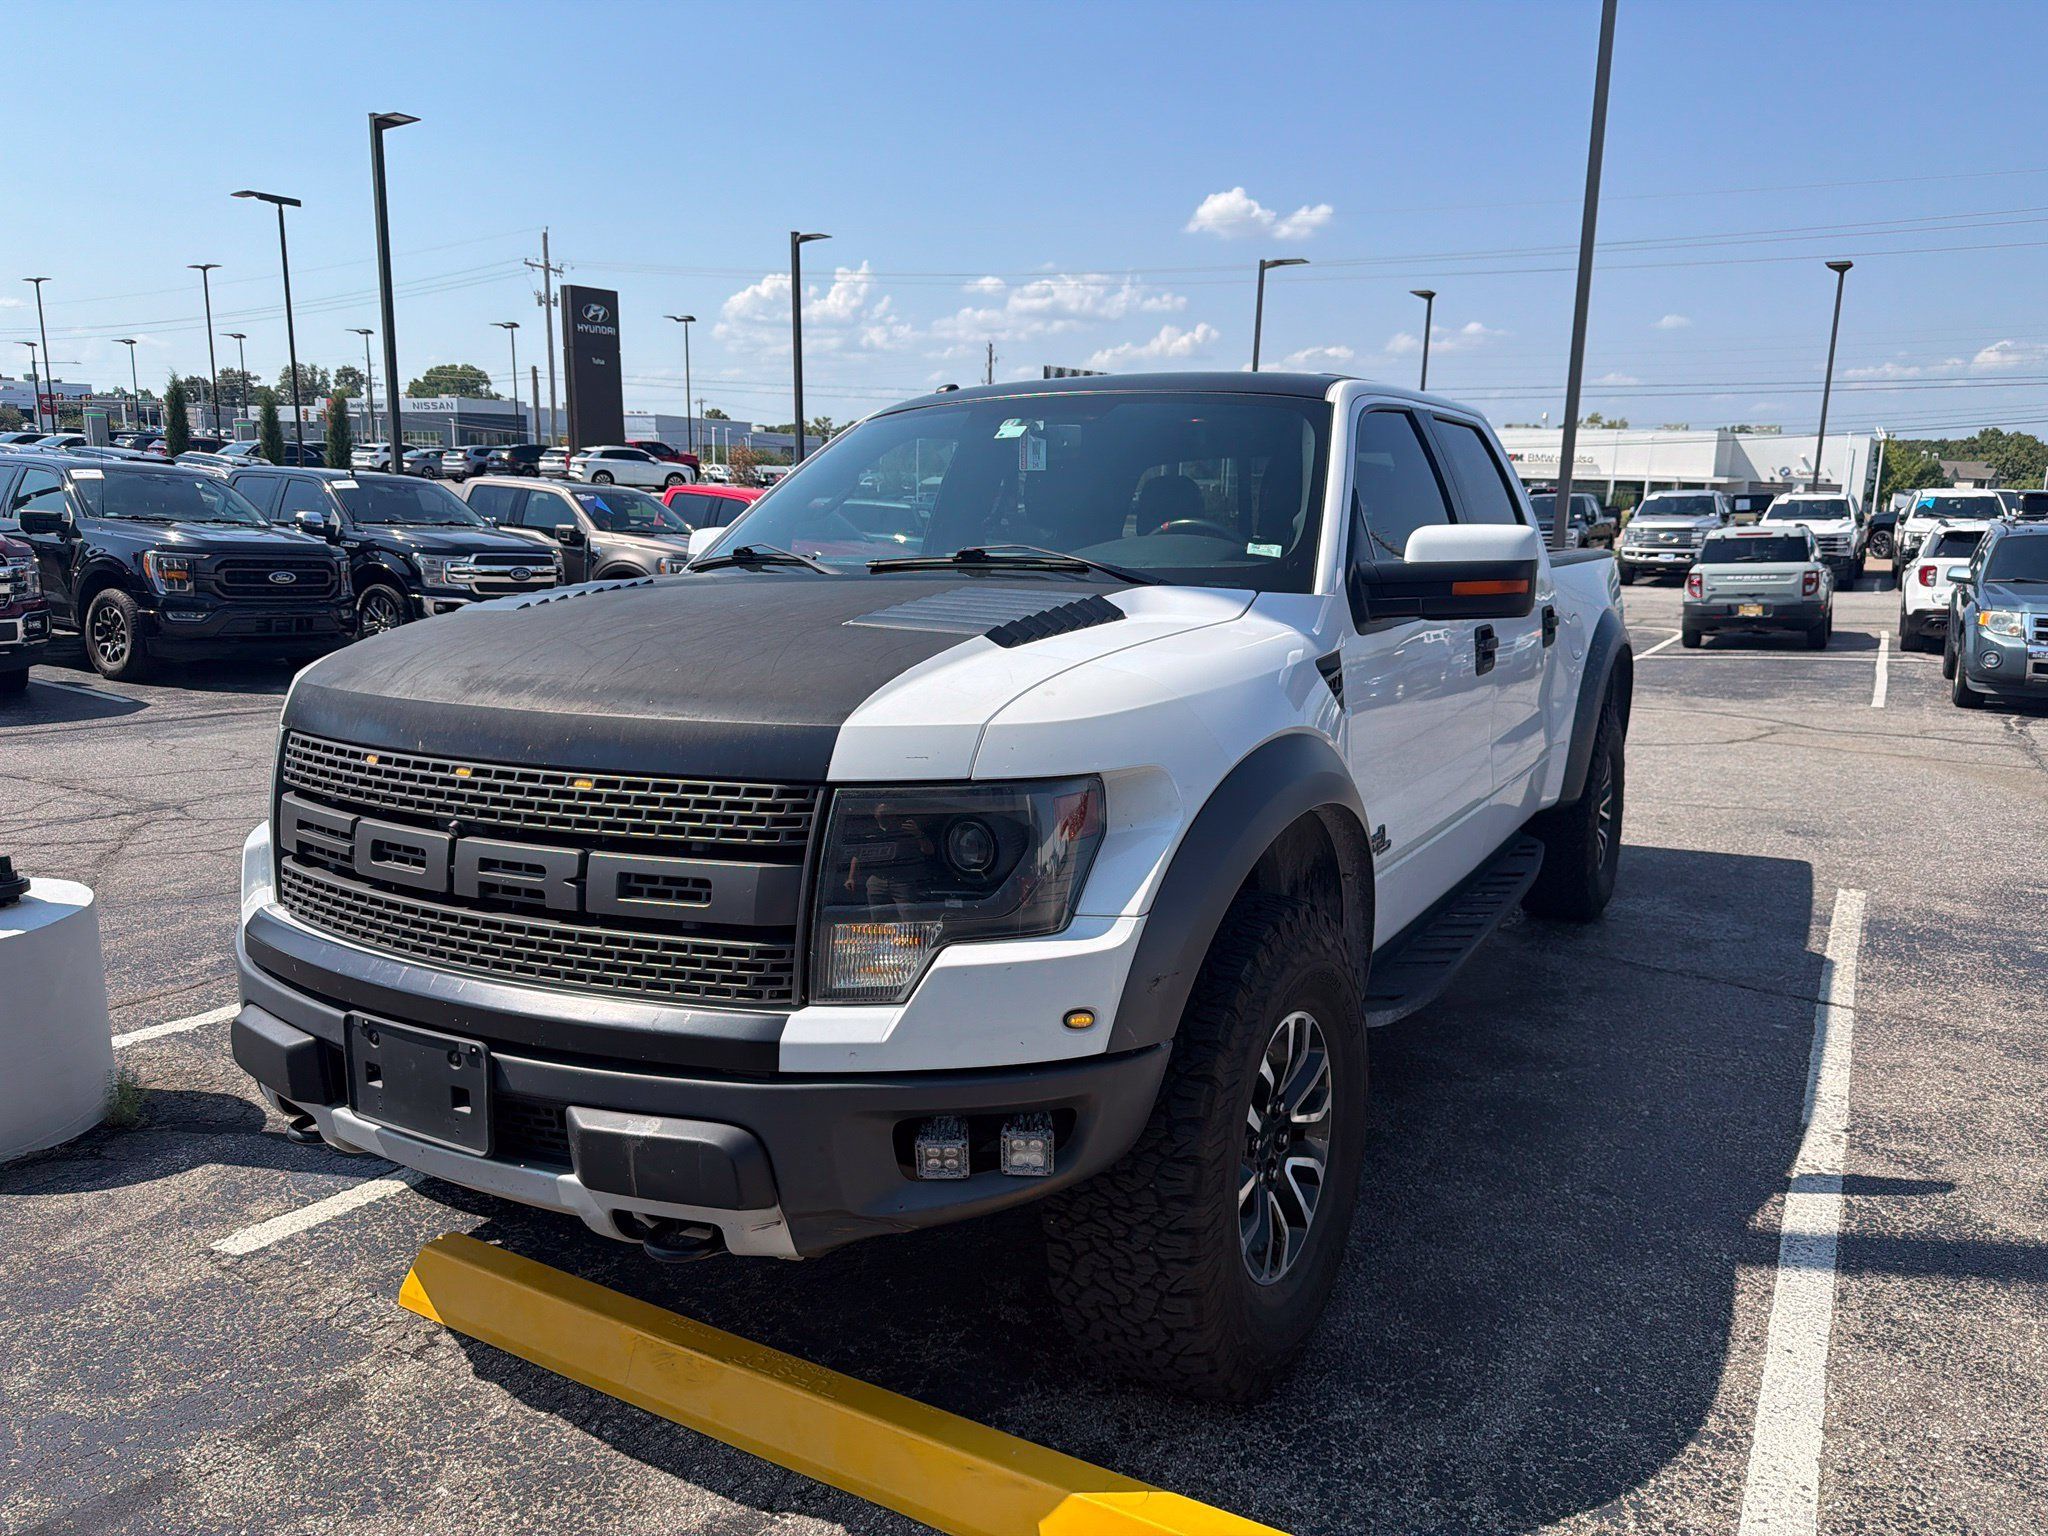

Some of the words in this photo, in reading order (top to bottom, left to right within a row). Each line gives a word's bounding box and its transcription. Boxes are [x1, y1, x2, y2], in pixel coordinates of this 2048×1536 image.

[576, 323, 616, 336] HYUNDAI
[591, 356, 606, 366] Tulsa
[412, 401, 454, 411] NISSAN
[1527, 453, 1554, 463] BMW
[281, 792, 802, 925] FORD
